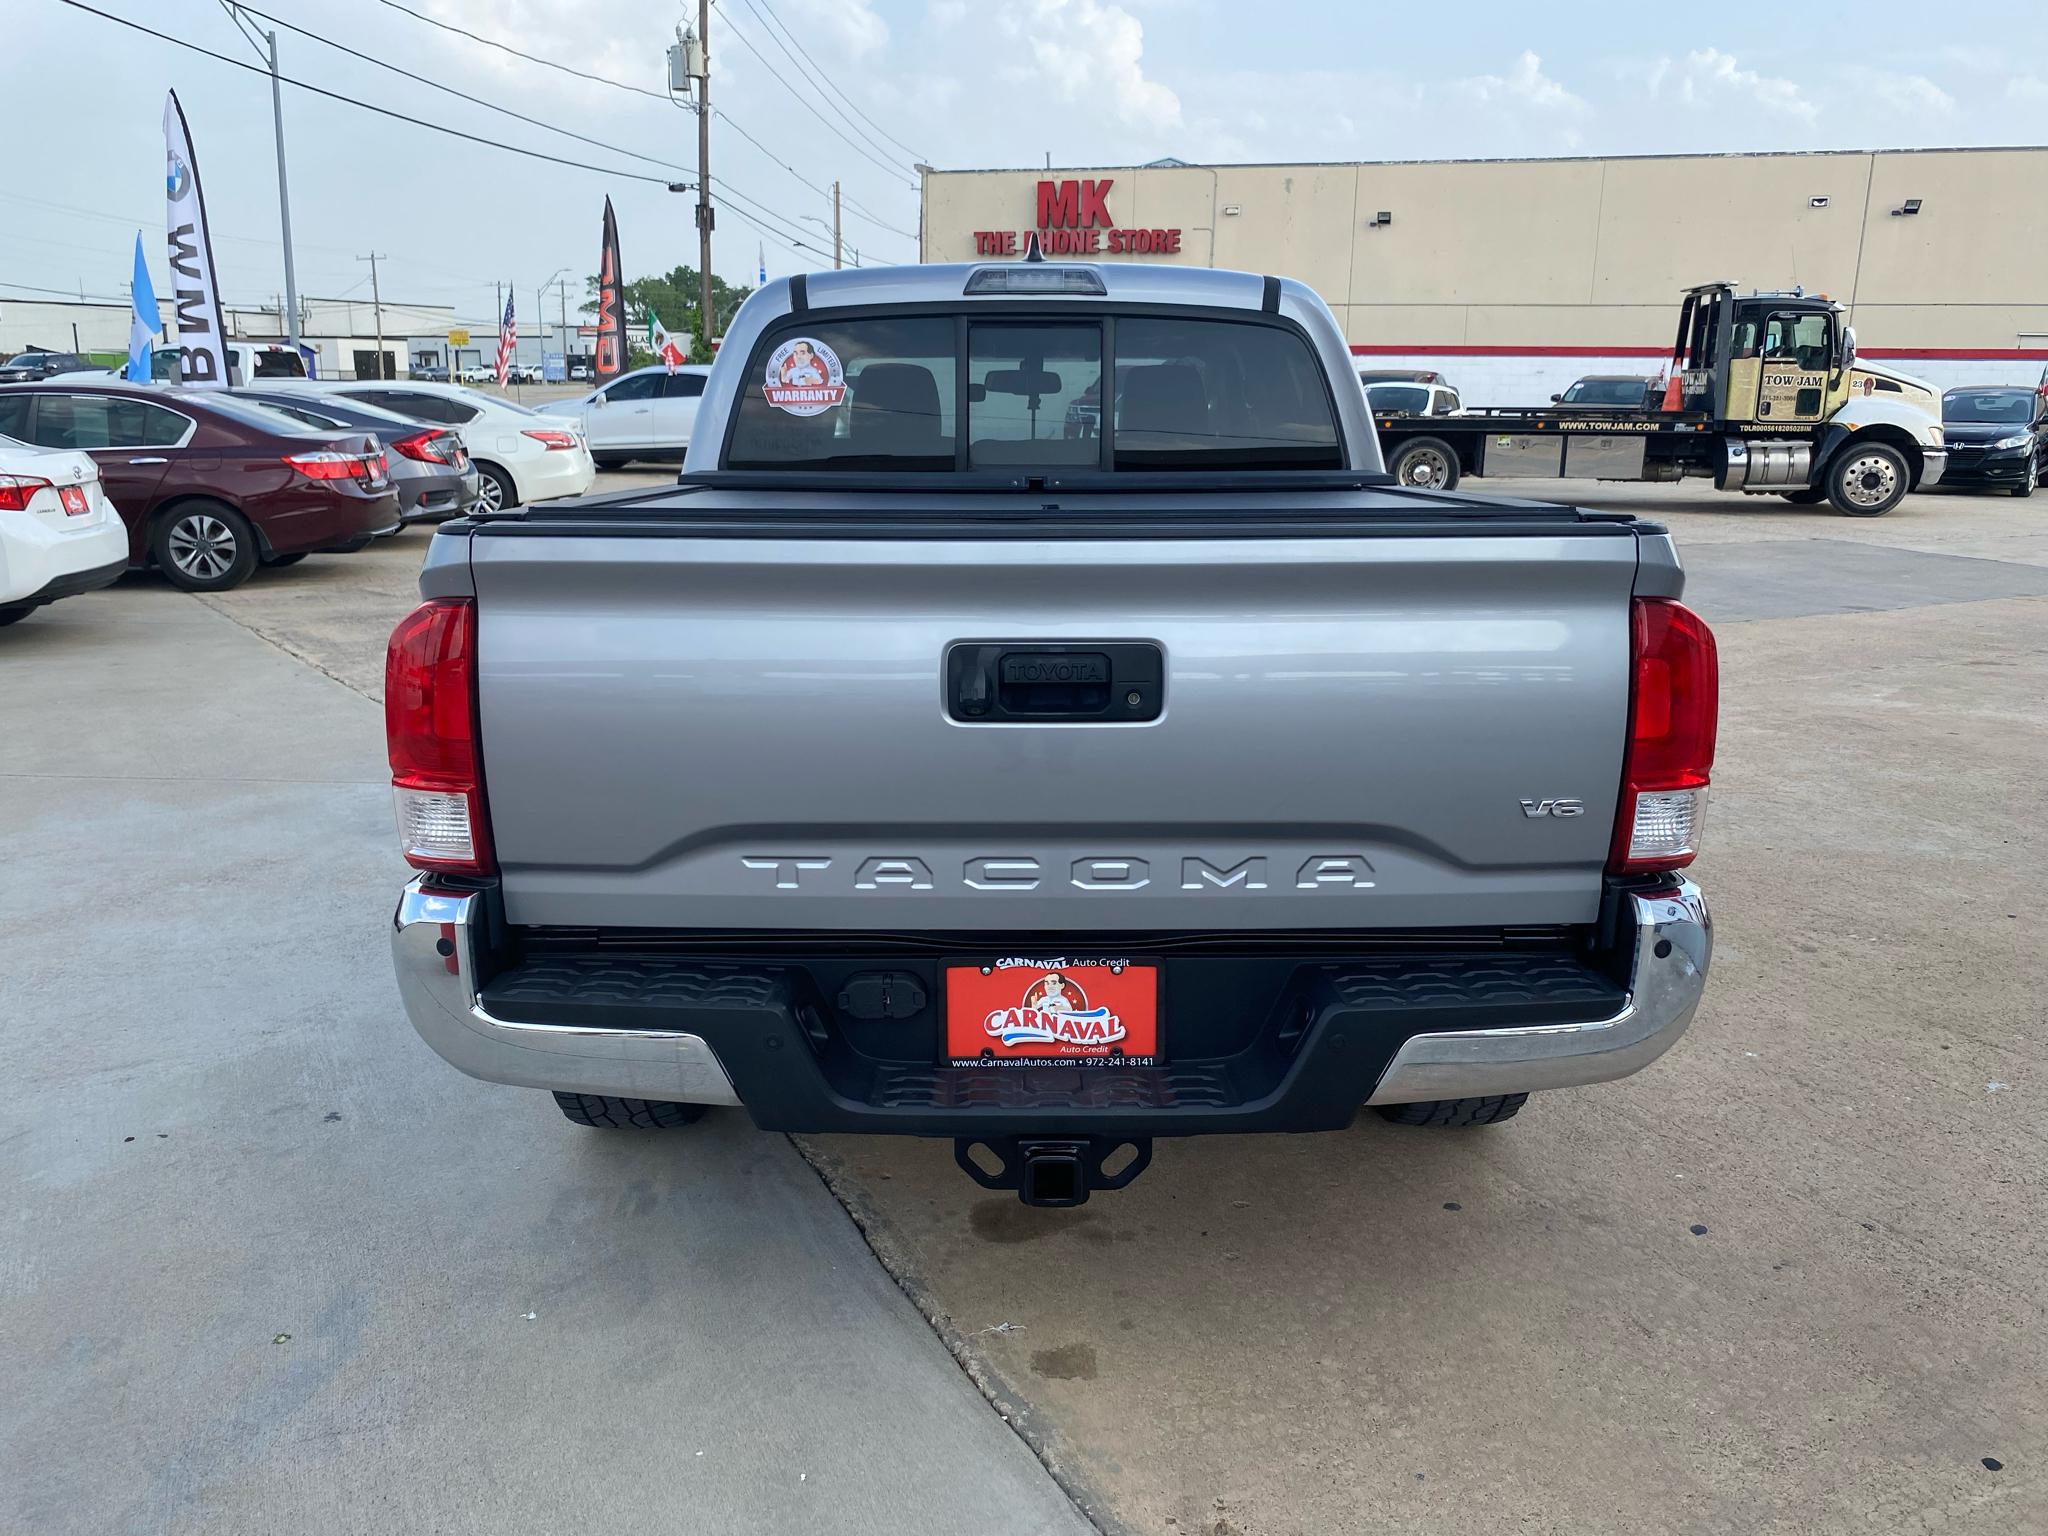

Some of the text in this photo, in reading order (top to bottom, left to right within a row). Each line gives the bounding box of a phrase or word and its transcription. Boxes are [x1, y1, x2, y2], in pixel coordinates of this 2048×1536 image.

[1037, 179, 1113, 228] MK
[974, 231, 1016, 255] THE
[1107, 228, 1181, 253] STORE
[775, 347, 837, 367] FREE LIMITED
[1765, 375, 1823, 387] TOW JAM
[772, 389, 837, 402] WARRANTY
[1559, 422, 1660, 431] WWW.TOWJAM.COM
[1009, 663, 1103, 681] TOYOTA
[1520, 798, 1584, 818] V6
[741, 856, 1377, 891] TACOMA
[996, 957, 1130, 969] CARNAVAL Auto Credit
[984, 1008, 1123, 1041] CARNAVAL
[1082, 1045, 1108, 1053] Credit
[952, 1057, 1153, 1067] www.CarnavalAutos.com 972-241-8141
